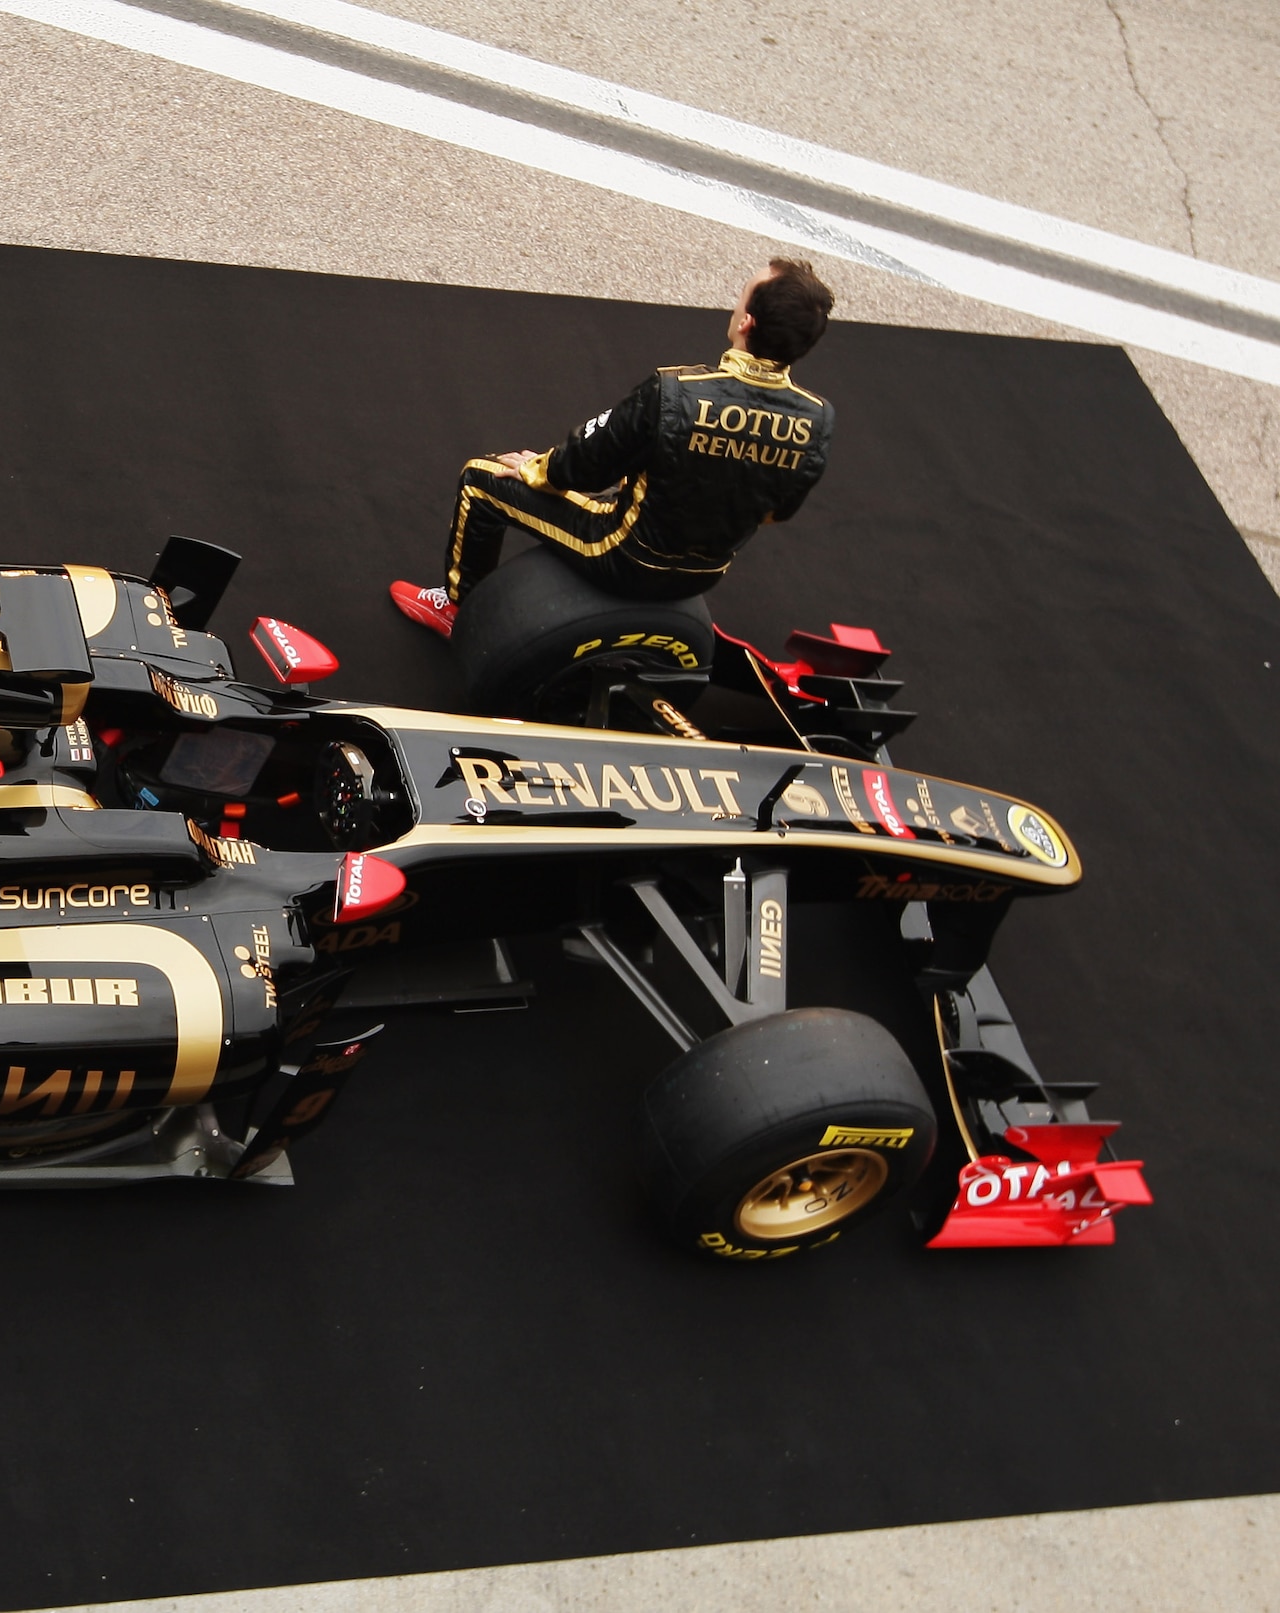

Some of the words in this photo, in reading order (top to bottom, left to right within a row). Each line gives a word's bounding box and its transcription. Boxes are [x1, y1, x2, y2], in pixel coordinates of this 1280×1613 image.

[695, 399, 812, 445] LOTUS
[688, 432, 805, 470] RENAULT
[267, 618, 301, 669] TOTAL
[617, 633, 698, 669] ZERO
[455, 757, 742, 817] RENAULT
[870, 775, 905, 836] TOTAL
[345, 855, 365, 906] TOTAL
[819, 1125, 914, 1149] PIRELLI
